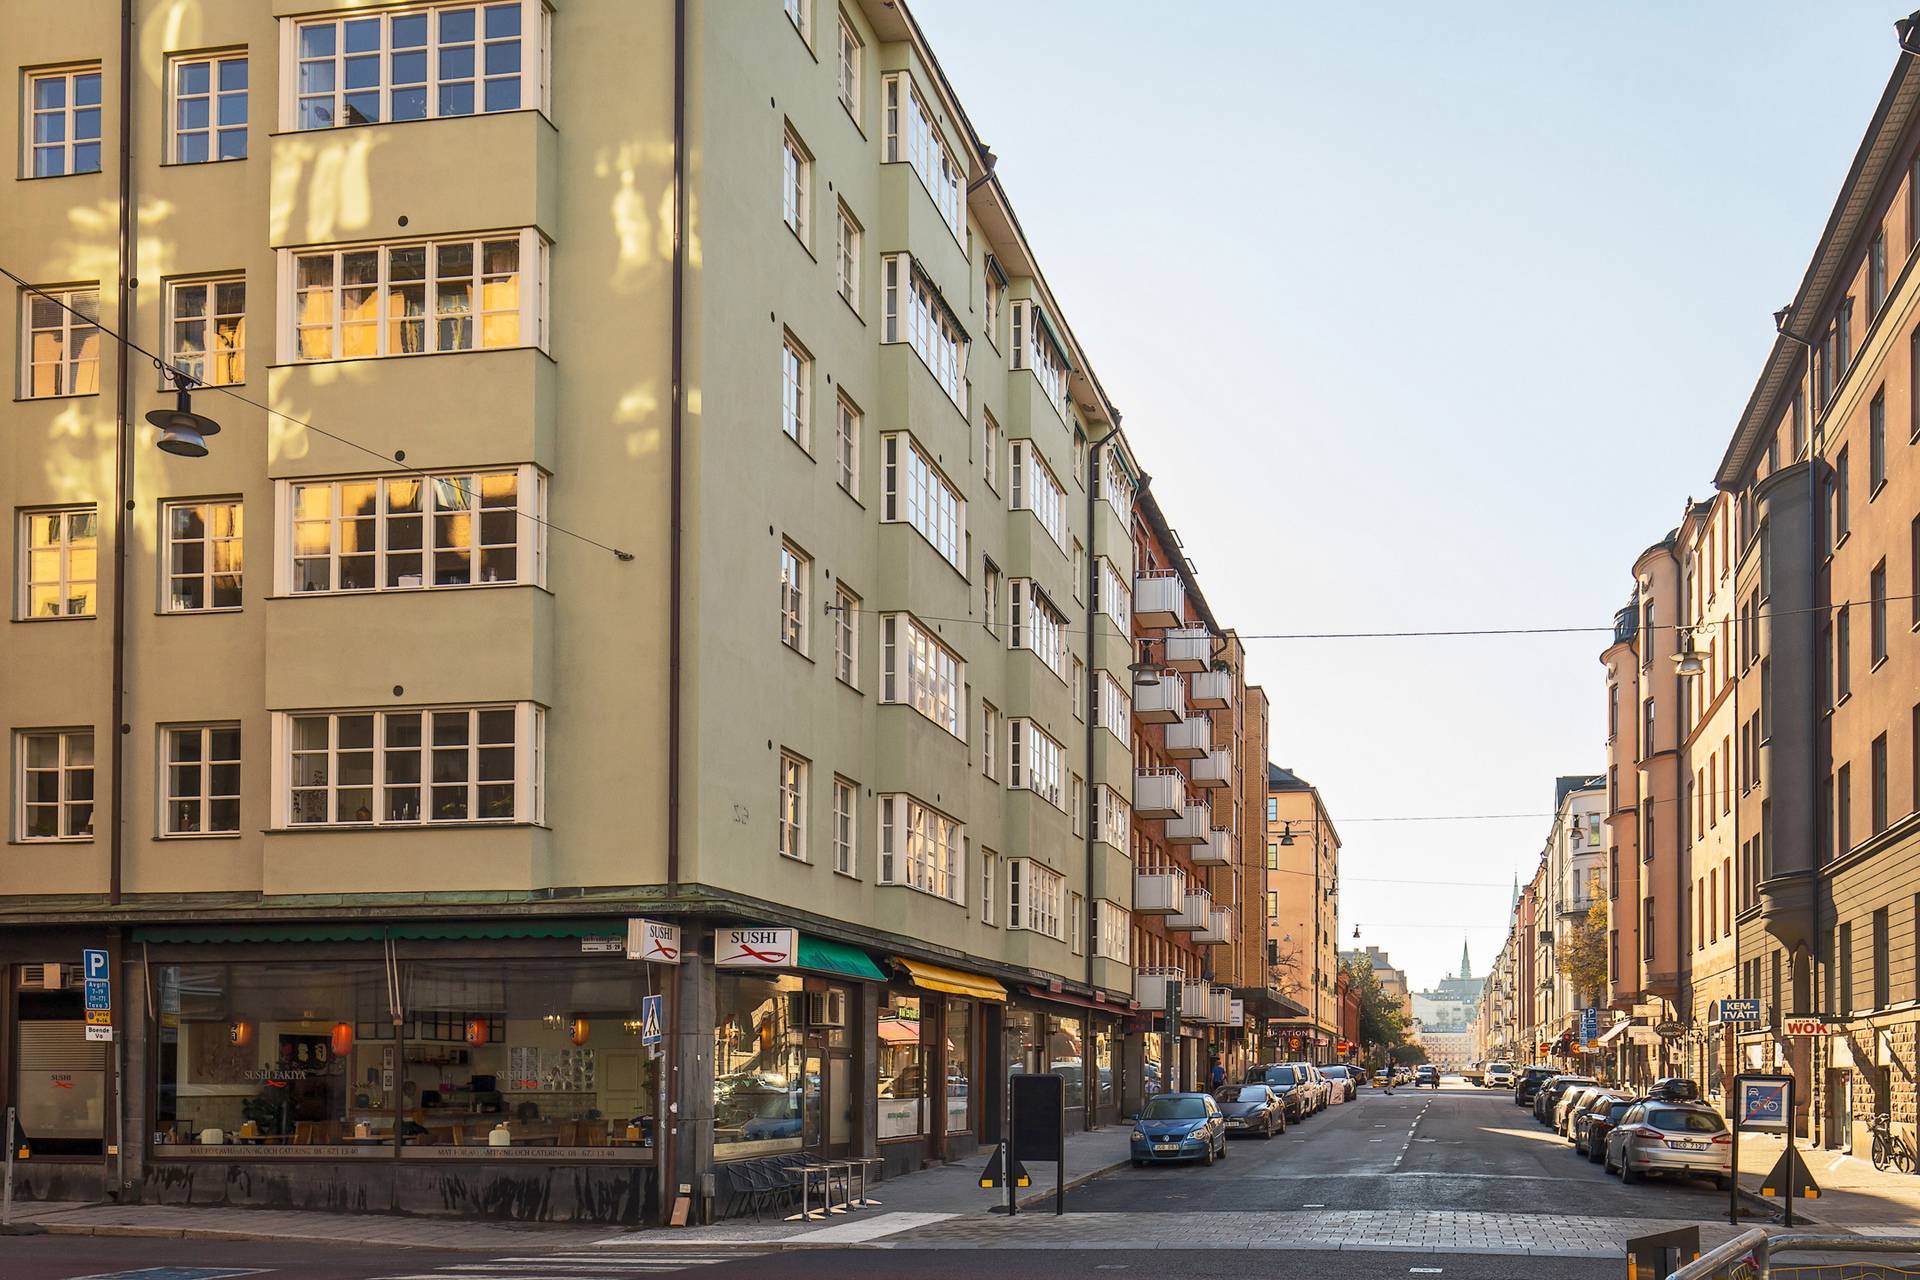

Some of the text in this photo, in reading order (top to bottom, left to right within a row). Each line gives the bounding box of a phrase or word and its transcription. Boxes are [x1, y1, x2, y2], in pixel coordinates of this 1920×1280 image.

[649, 924, 673, 941] SUSHI
[730, 931, 777, 944] SUSHI
[90, 953, 105, 977] P
[1726, 1002, 1755, 1010] KEM-
[1588, 1008, 1594, 1018] P
[1722, 1010, 1759, 1019] TVÄTT
[1788, 1023, 1828, 1034] WOK
[244, 1071, 271, 1080] SUSHI
